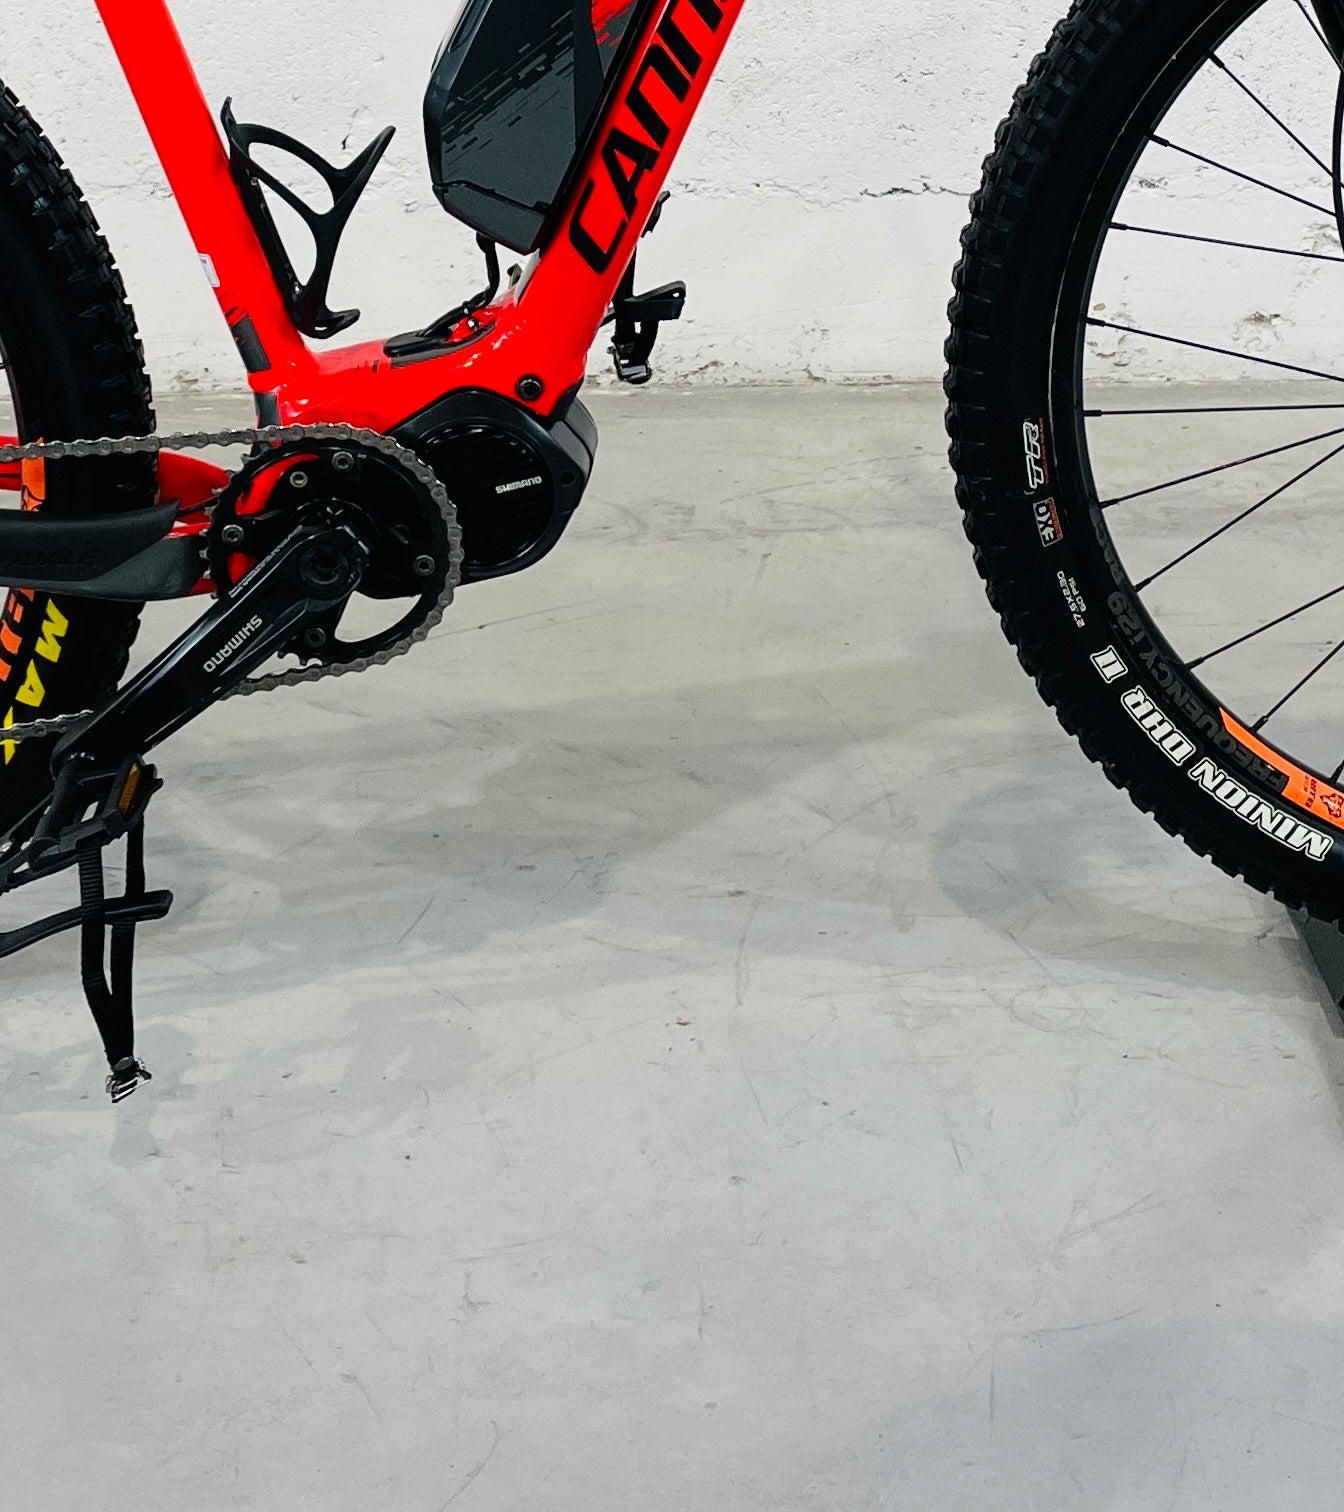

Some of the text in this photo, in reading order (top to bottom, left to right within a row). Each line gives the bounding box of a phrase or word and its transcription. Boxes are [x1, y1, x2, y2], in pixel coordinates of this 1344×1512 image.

[495, 475, 543, 494] SHIMANO
[1022, 421, 1044, 489] TR
[202, 614, 264, 674] SHIMANO
[1120, 685, 1197, 766] DHR
[1138, 649, 1289, 792] FREQUENCY
[1187, 756, 1334, 862] MINION
